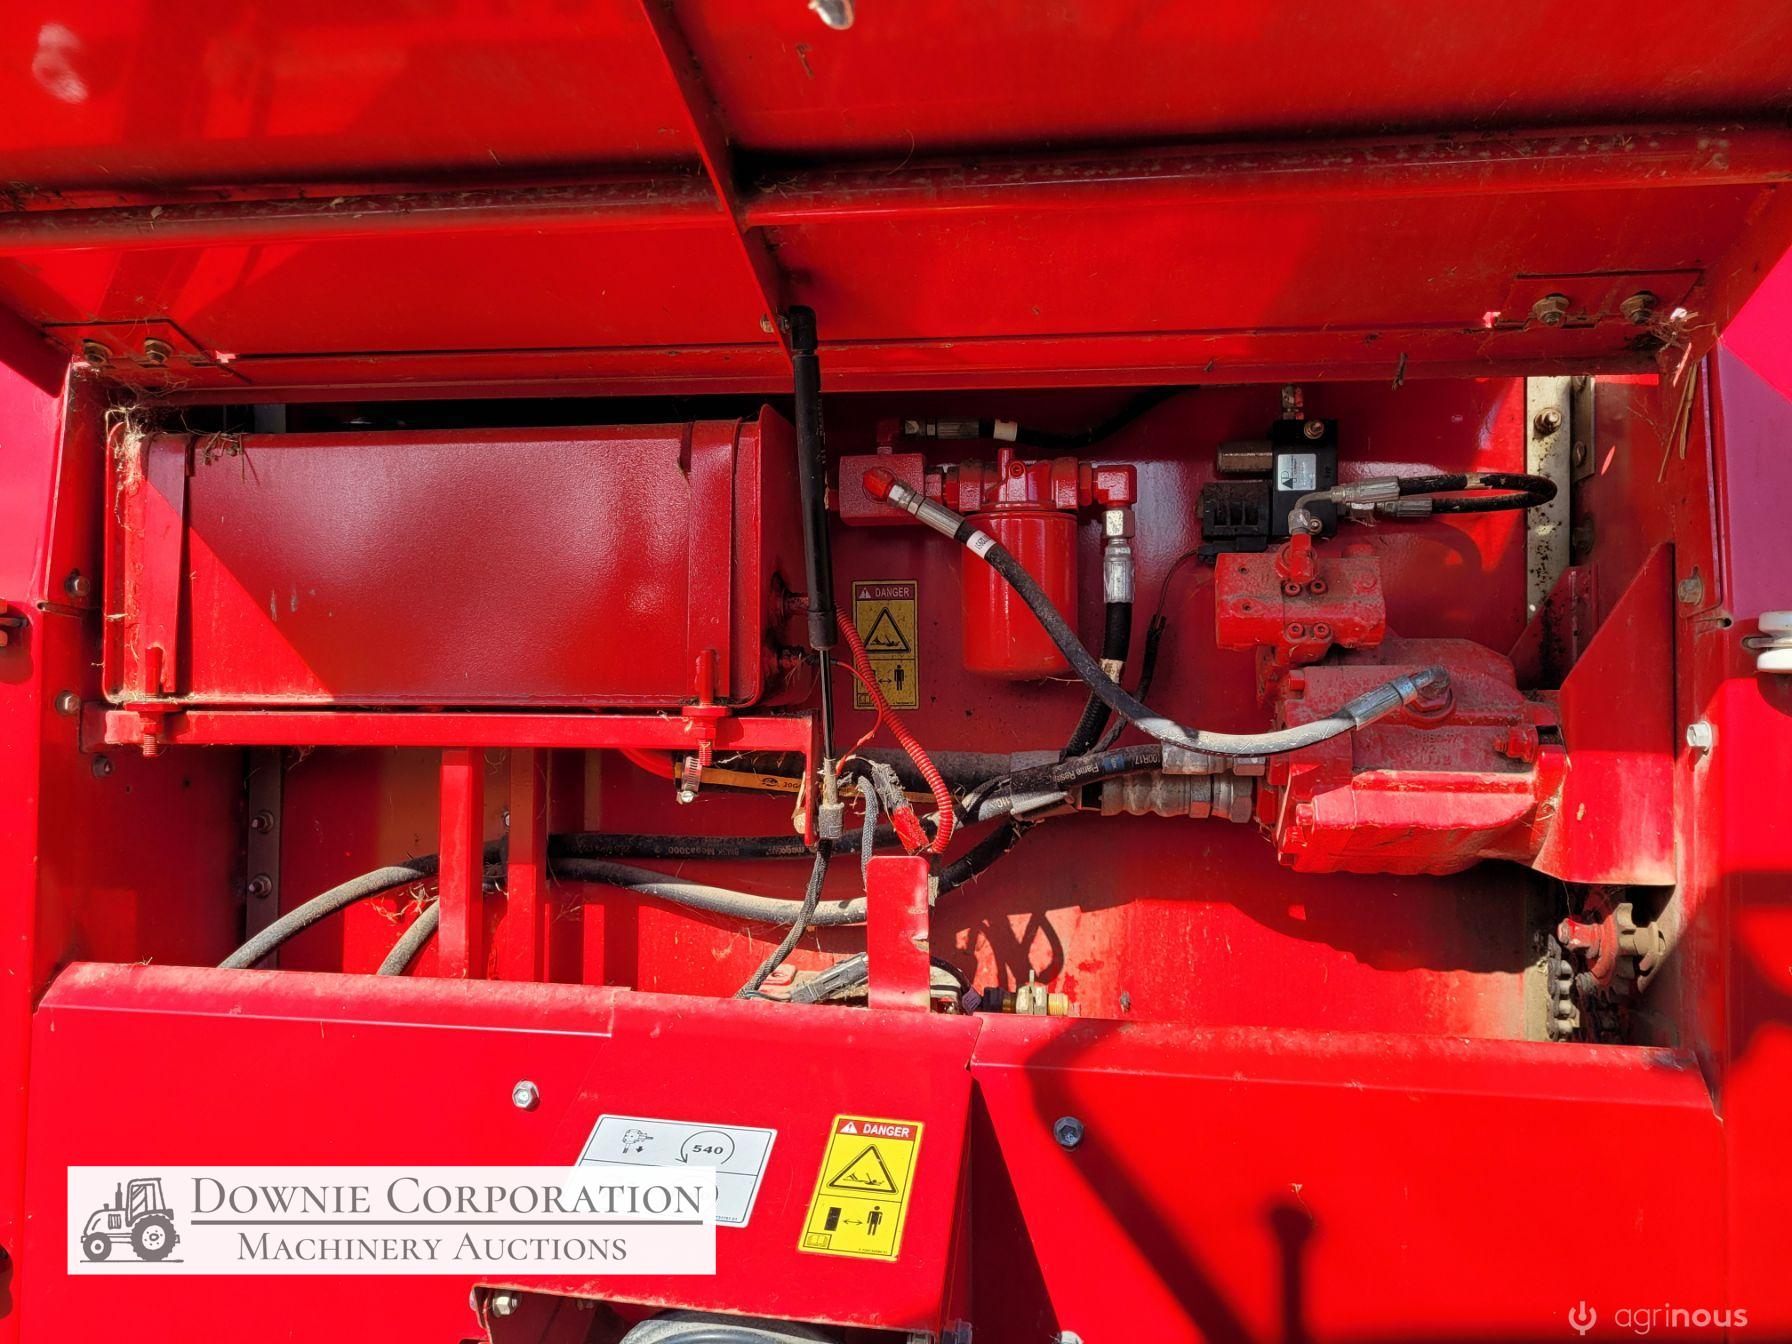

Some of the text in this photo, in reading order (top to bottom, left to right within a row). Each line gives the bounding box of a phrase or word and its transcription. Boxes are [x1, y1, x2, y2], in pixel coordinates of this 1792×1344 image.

[875, 587, 910, 598] DANGER
[863, 1123, 910, 1139] DANGER
[692, 1143, 724, 1157] 540
